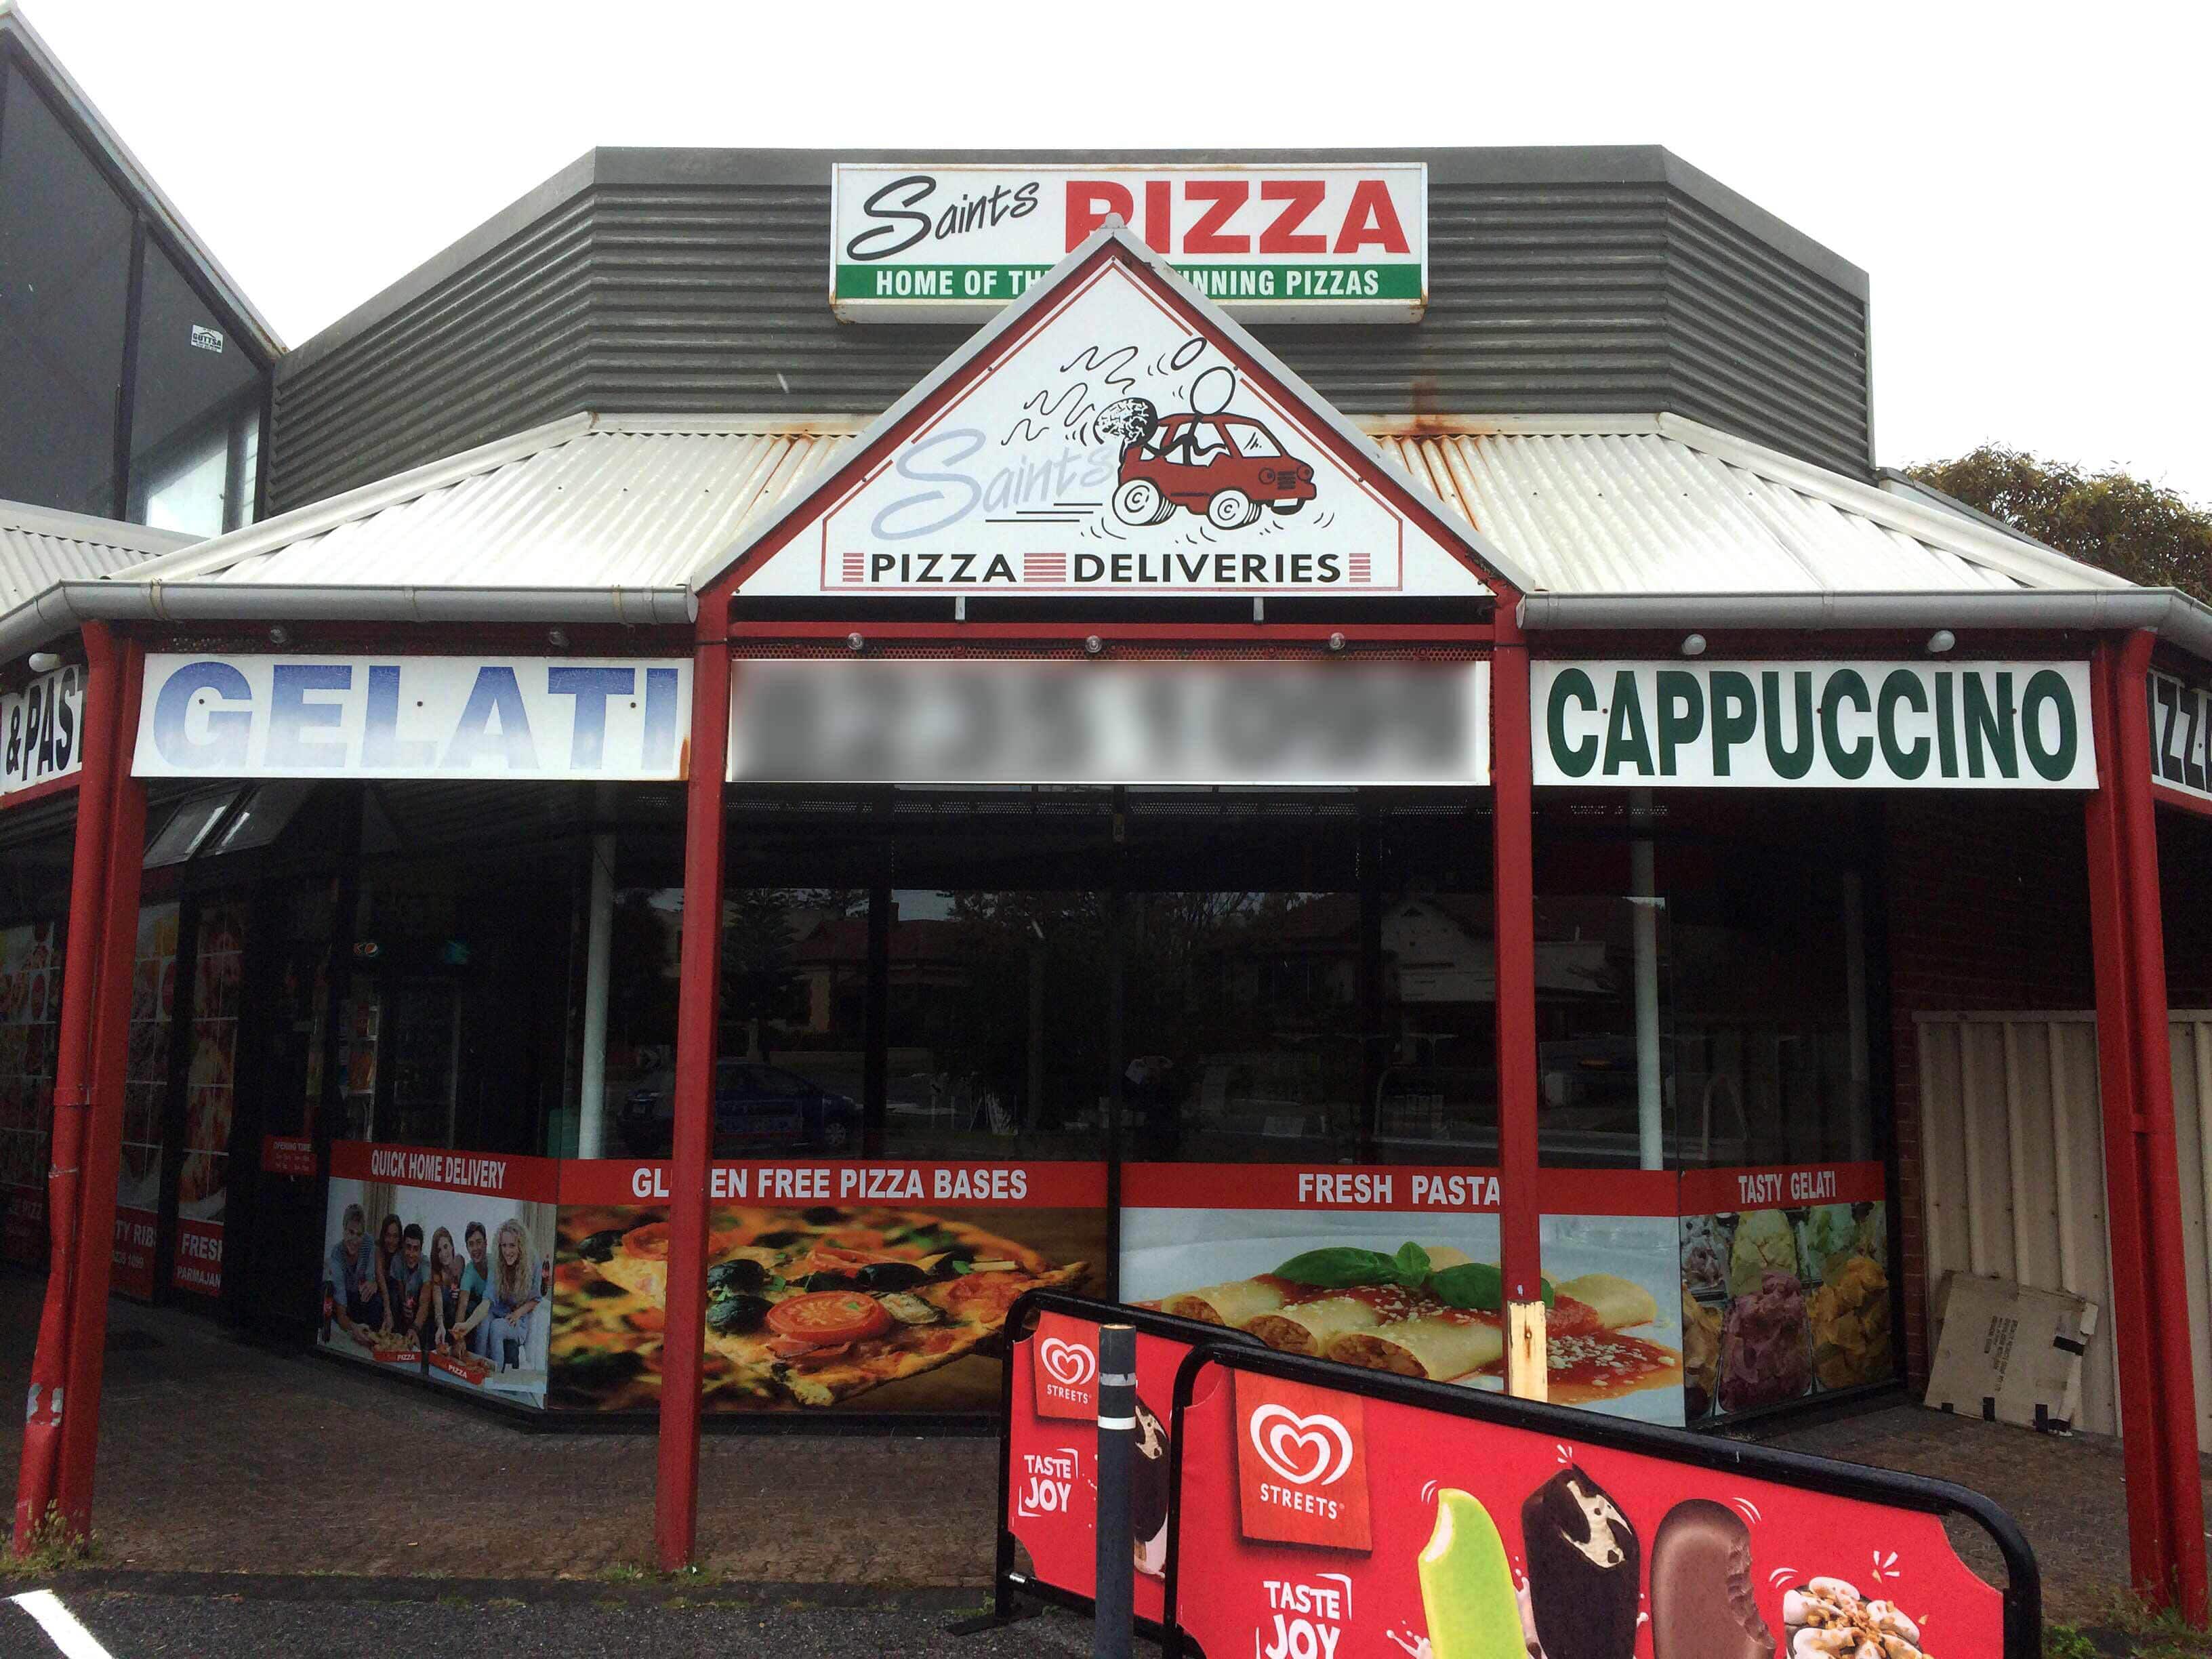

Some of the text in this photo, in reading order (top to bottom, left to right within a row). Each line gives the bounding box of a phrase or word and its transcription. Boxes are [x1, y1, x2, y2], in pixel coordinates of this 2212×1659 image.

[846, 175, 1411, 262] Saints PIZZA
[876, 270, 1379, 295] HOME OF TH NNING PIZZAS
[871, 428, 1115, 540] Saints
[871, 553, 1342, 583] PIZZA DELIVERIES
[153, 661, 679, 770] GELATI
[1546, 668, 2078, 781] CAPPUCCINO
[6, 705, 21, 775] &
[371, 1149, 507, 1189] QUICK HOME DELIVERY
[632, 1168, 1027, 1199] GLEN FREE PIZZA BASES
[1738, 1170, 1837, 1204] TASTY GELATI
[1298, 1173, 1500, 1206] FRESH PASTA
[448, 1364, 468, 1379] PIZZA
[1047, 1384, 1088, 1404] STREETS
[1023, 1454, 1071, 1479] TASTE
[1024, 1476, 1071, 1513] JOY
[1260, 1483, 1338, 1519] STREETS
[1263, 1580, 1340, 1620] TASTE
[1265, 1614, 1341, 1659] JOY
